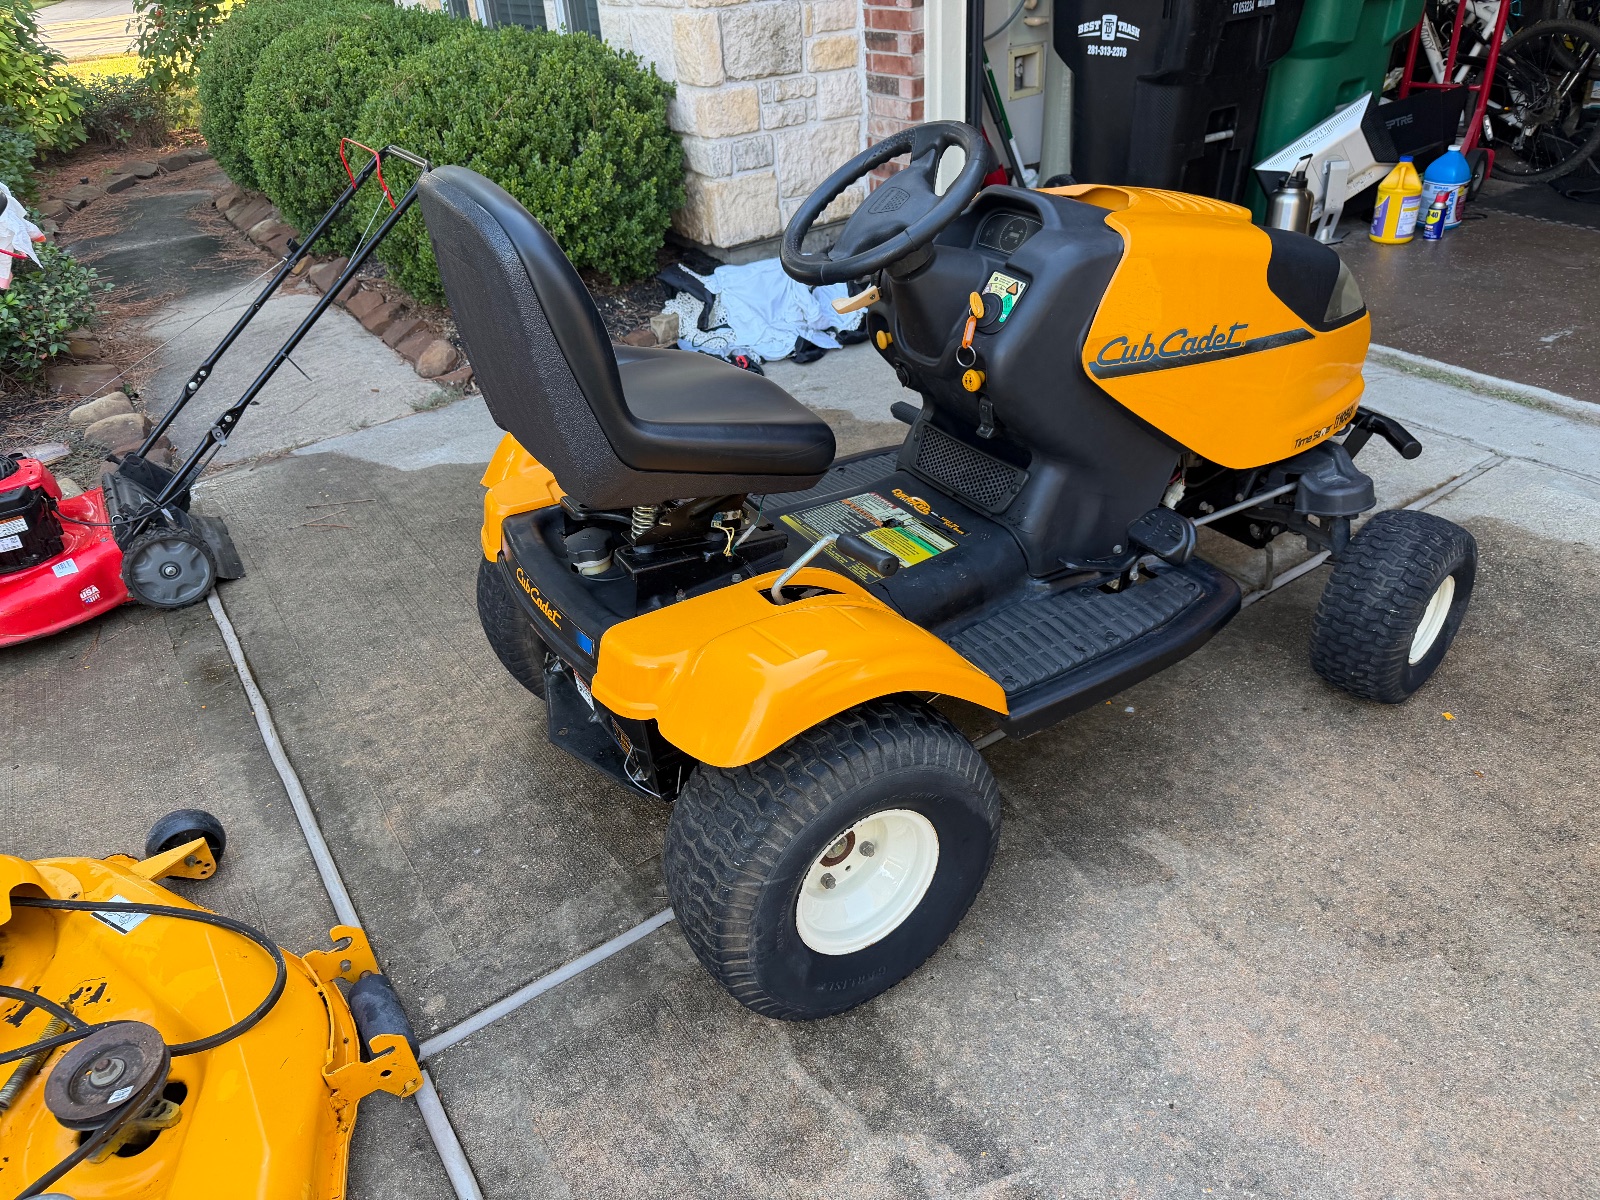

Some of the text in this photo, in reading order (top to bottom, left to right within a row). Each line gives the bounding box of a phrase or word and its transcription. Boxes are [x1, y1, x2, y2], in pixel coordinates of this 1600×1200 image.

[1078, 20, 1101, 34] BEST
[1118, 21, 1140, 38] TRASH
[1097, 322, 1249, 366] Cub Cadet
[80, 586, 100, 599] USA
[516, 568, 562, 630] Cub Cadet
